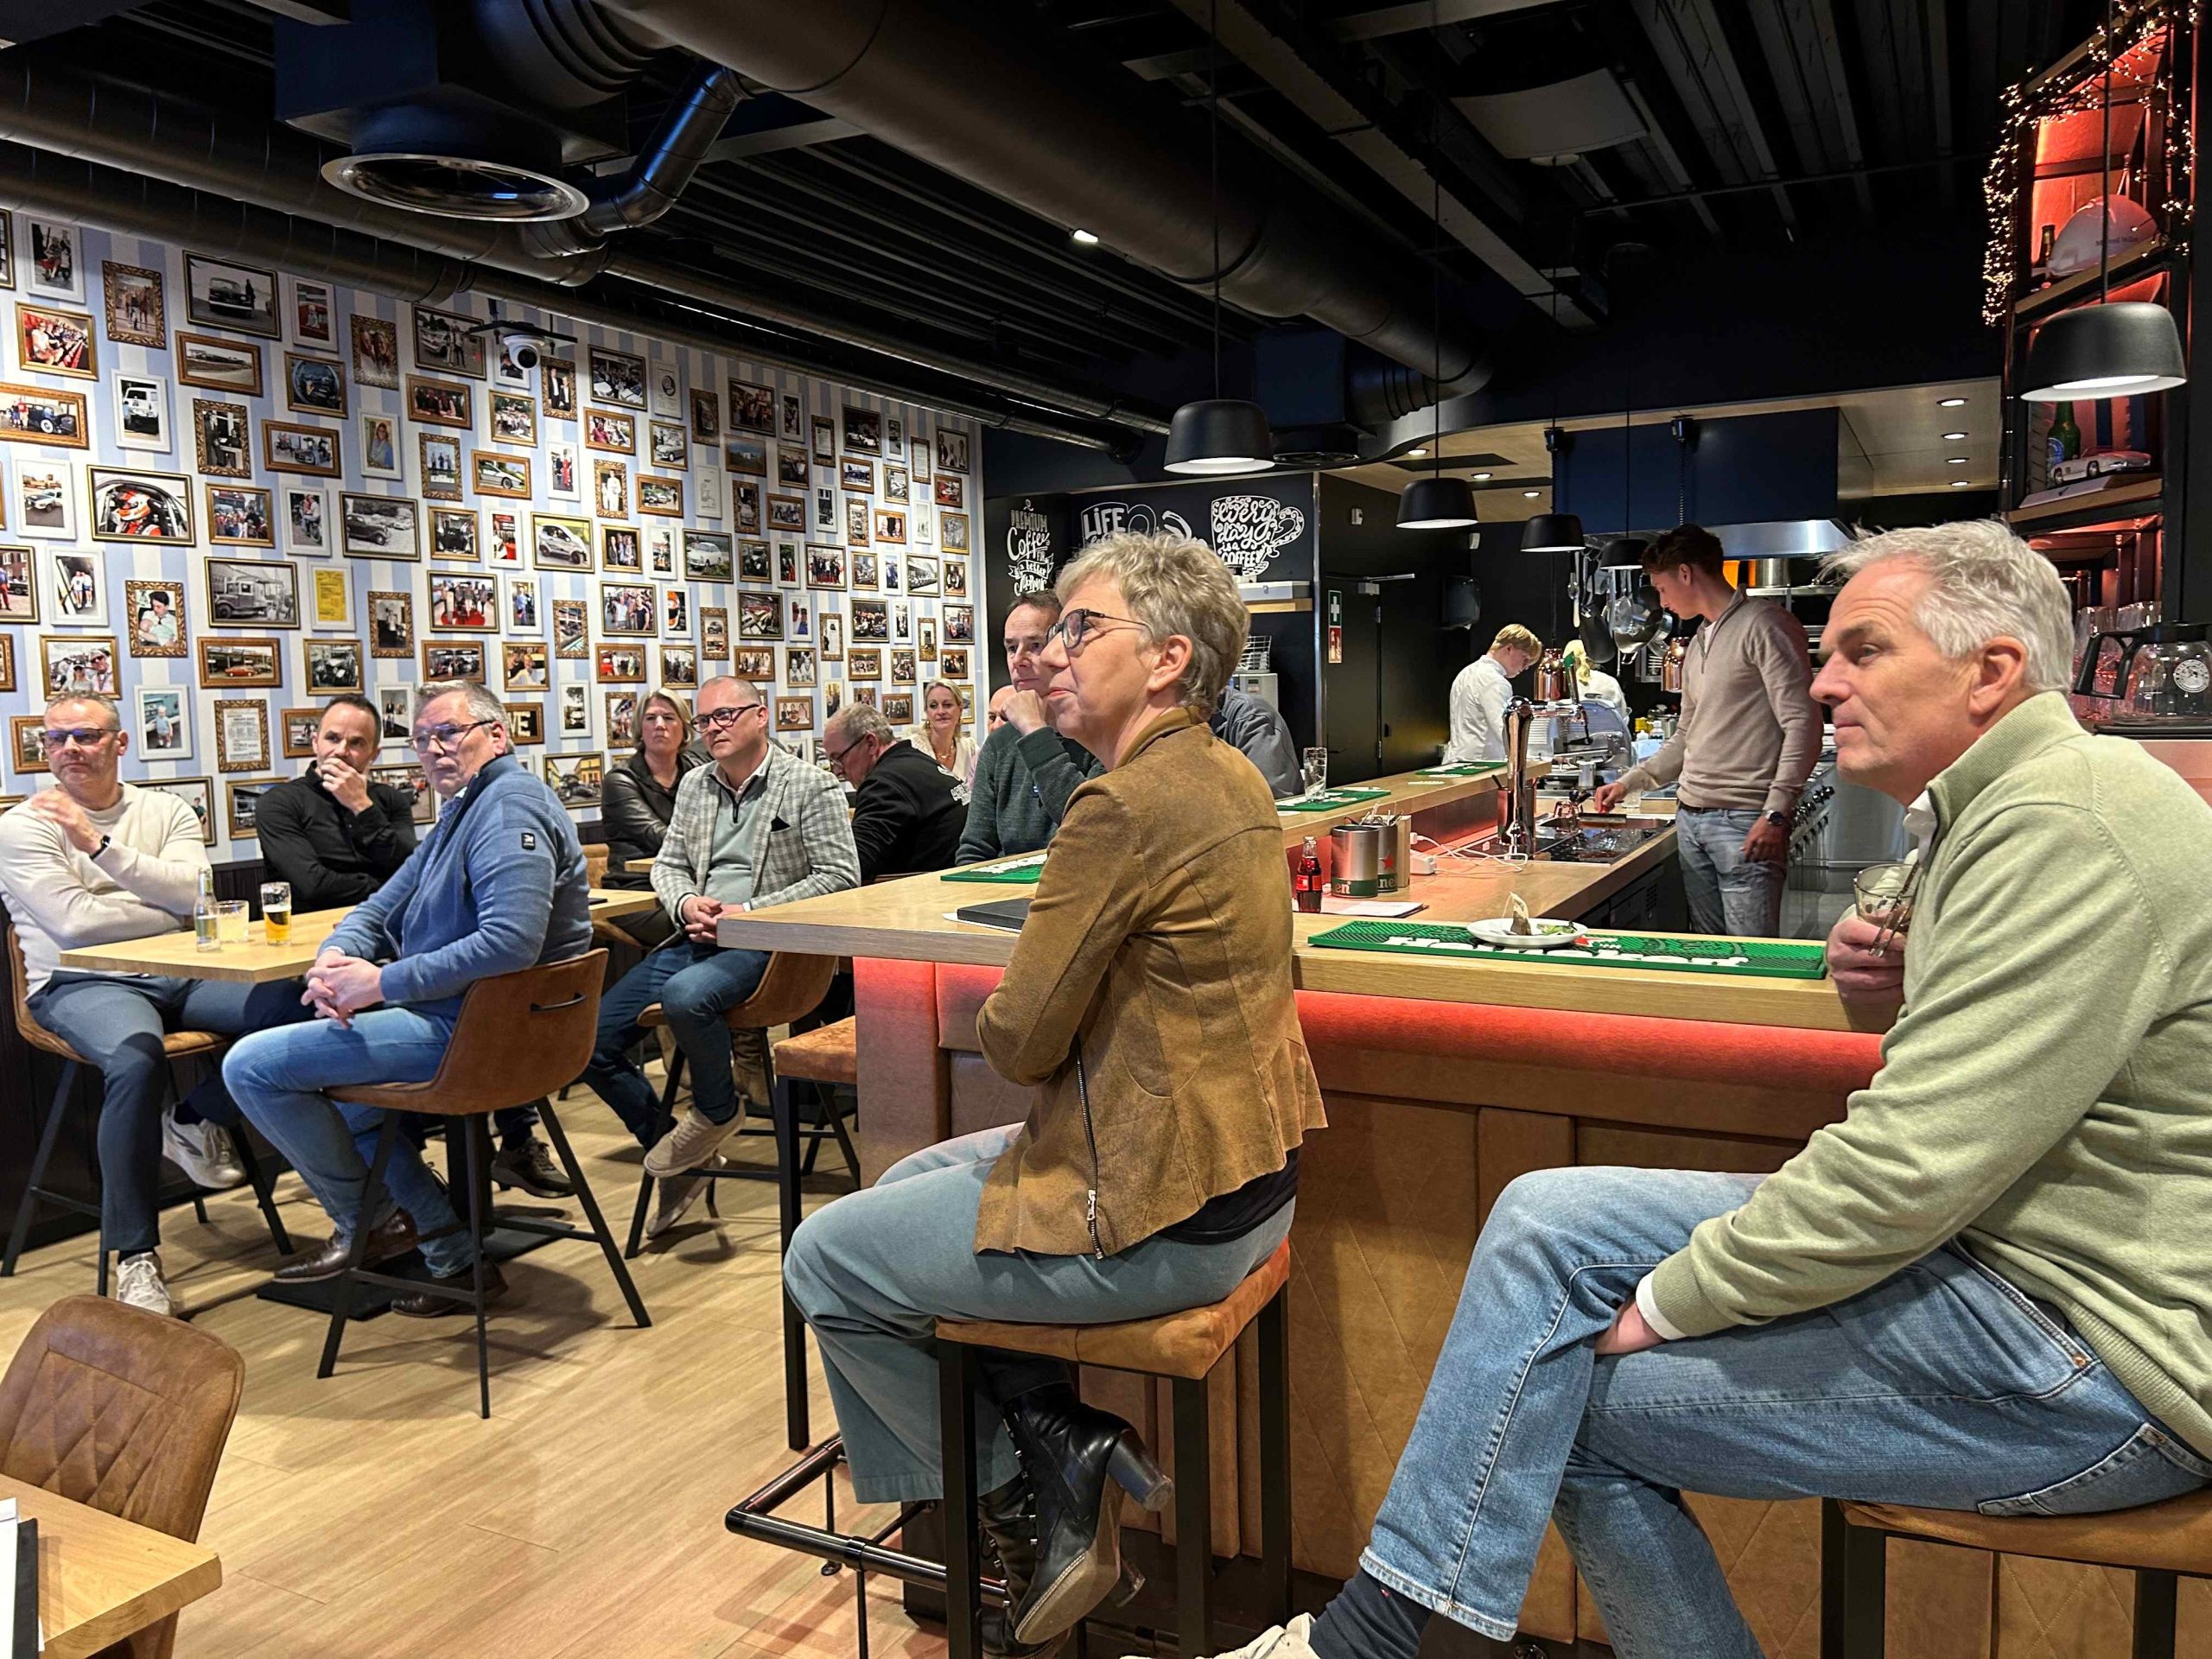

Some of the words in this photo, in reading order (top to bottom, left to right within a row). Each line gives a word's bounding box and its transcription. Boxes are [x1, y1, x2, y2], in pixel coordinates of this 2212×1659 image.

[1007, 526, 1050, 561] Coffee
[1217, 522, 1256, 550] day
[1221, 550, 1257, 568] COFFEE
